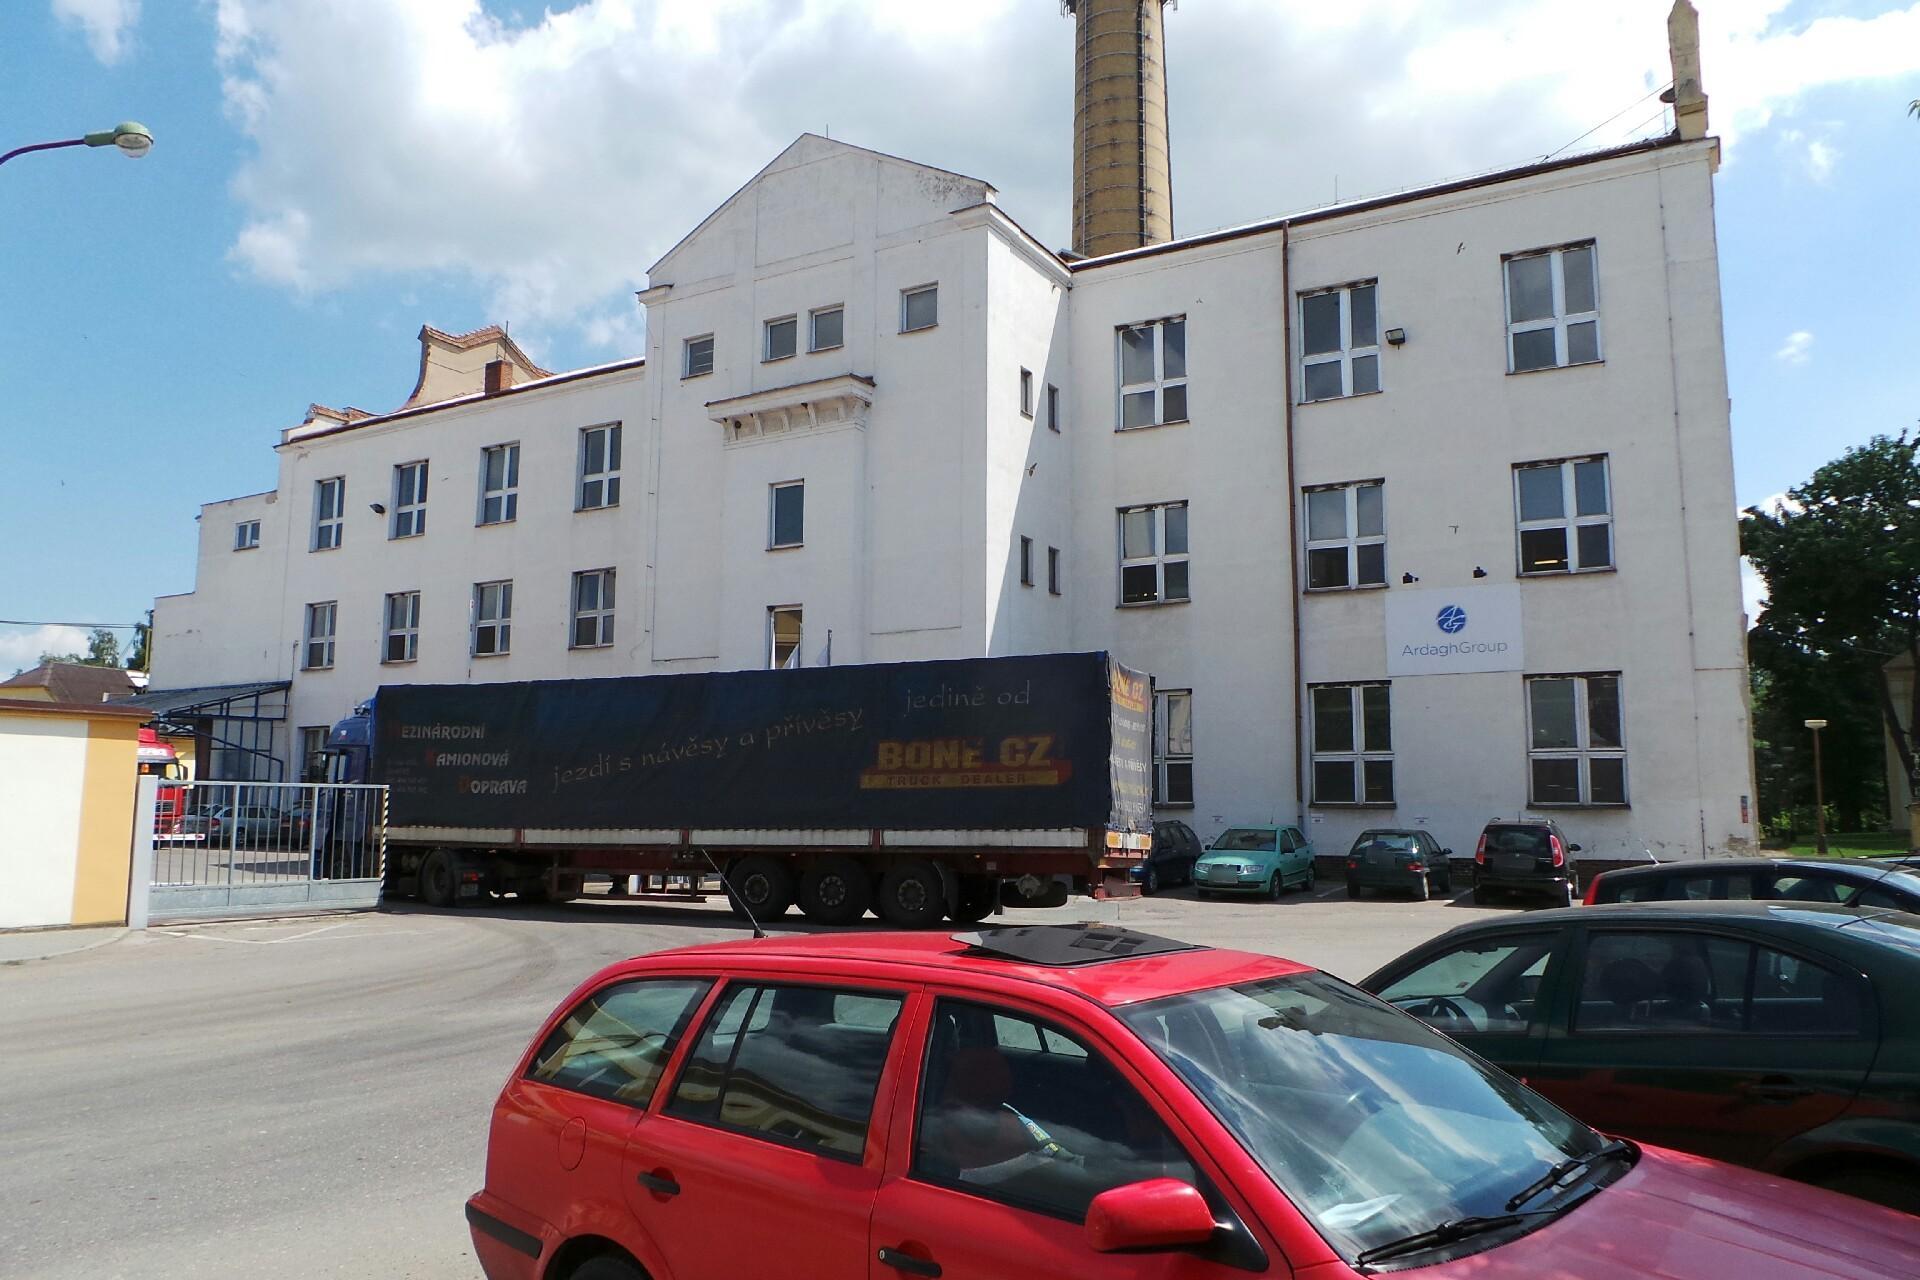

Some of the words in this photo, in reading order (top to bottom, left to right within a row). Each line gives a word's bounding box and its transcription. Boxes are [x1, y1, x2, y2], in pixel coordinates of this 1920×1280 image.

[1402, 642, 1508, 657] ArdaghGroup
[996, 679, 1031, 705] od
[552, 753, 611, 793] jezdí
[618, 757, 632, 773] s
[641, 736, 729, 767] návěsy
[738, 733, 755, 748] a
[766, 706, 864, 749] přívěsy
[999, 736, 1053, 767] CZ
[887, 774, 942, 786] TRUCK
[960, 773, 1027, 785] DEALER
